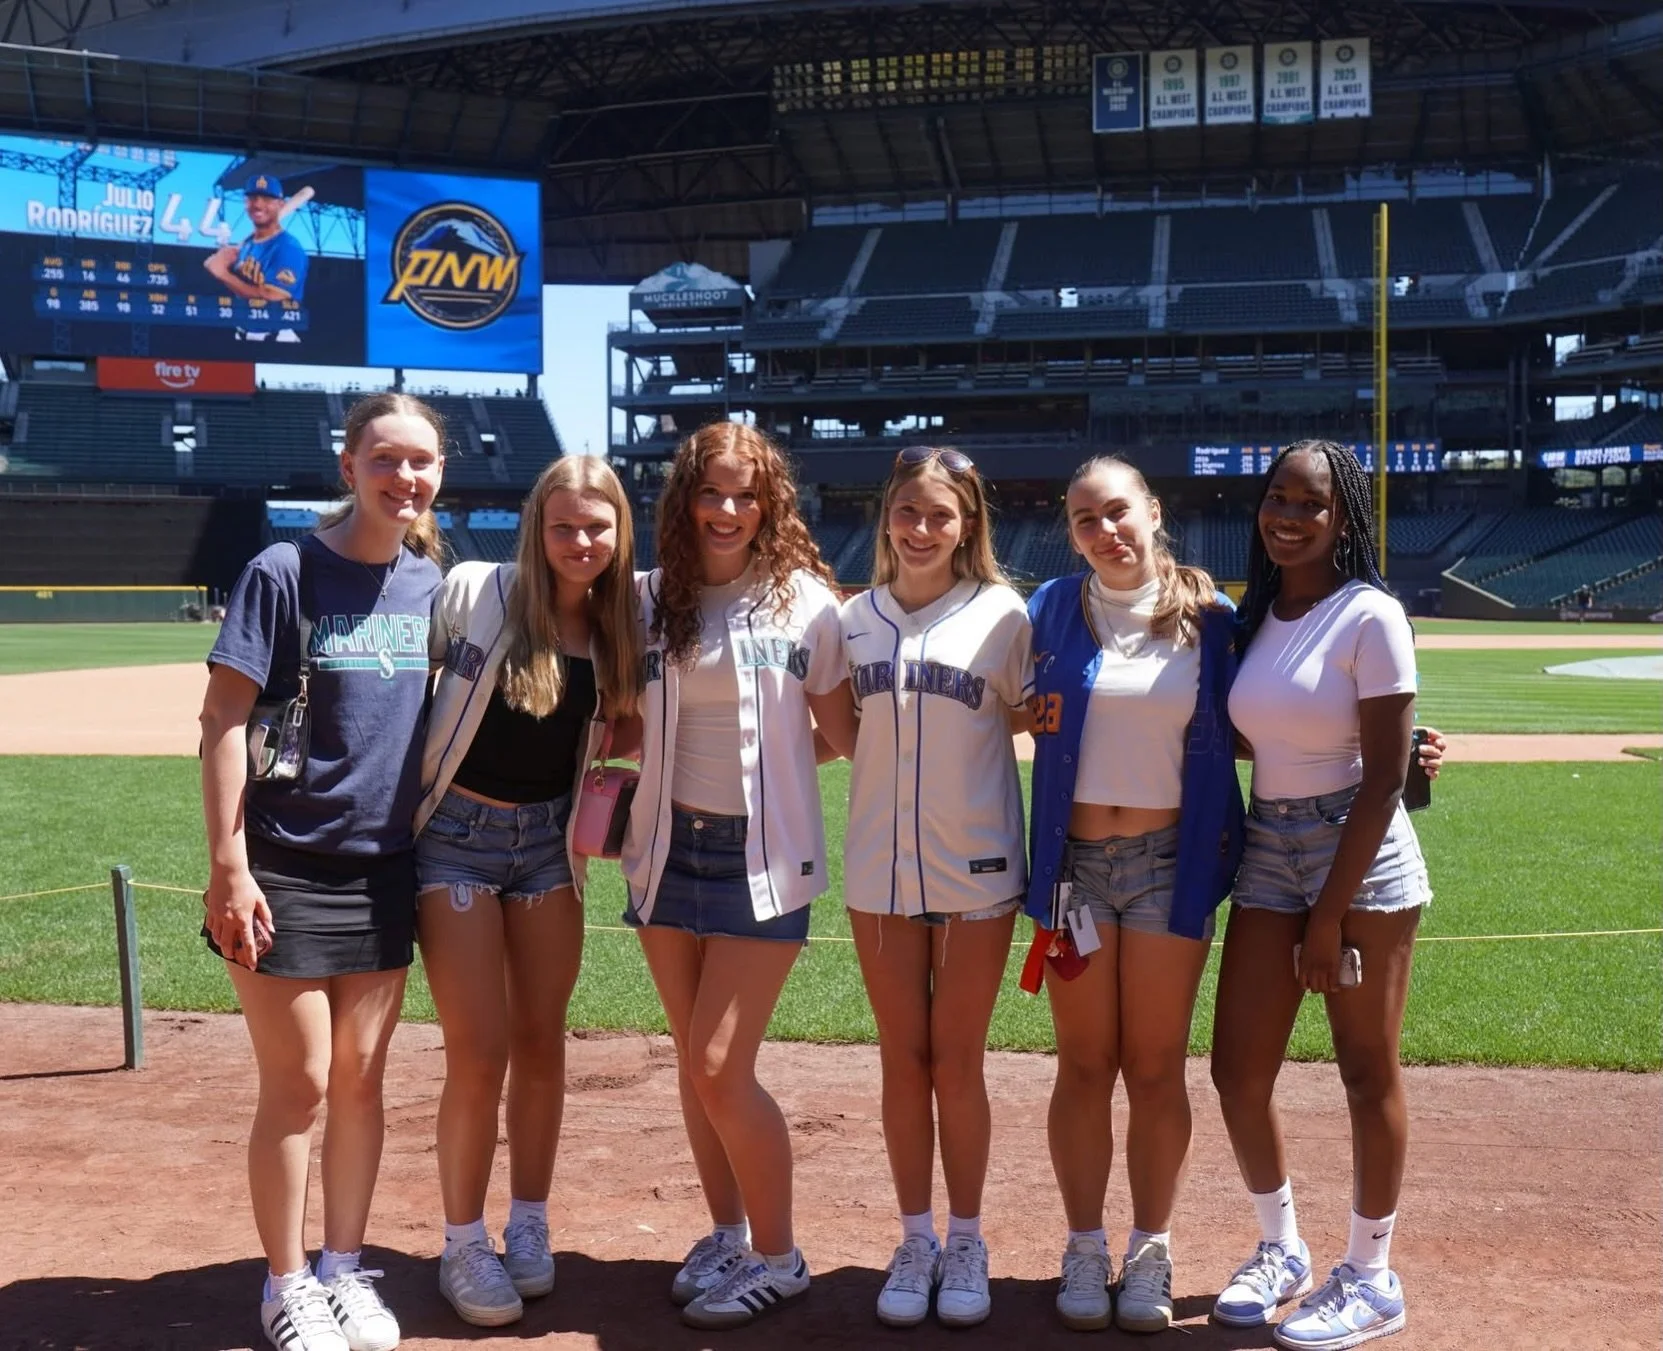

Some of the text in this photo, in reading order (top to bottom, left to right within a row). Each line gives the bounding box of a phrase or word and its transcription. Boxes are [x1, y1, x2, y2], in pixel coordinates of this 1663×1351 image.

[1207, 104, 1252, 117] CHAMPIONS
[1265, 101, 1310, 113] CHAMPIONS
[1152, 108, 1196, 120] CHAMPIONS
[103, 181, 154, 211] JULIO
[643, 291, 729, 303] MUCKLESHOOT
[155, 361, 200, 379] fire tv
[310, 614, 431, 656] MARINER
